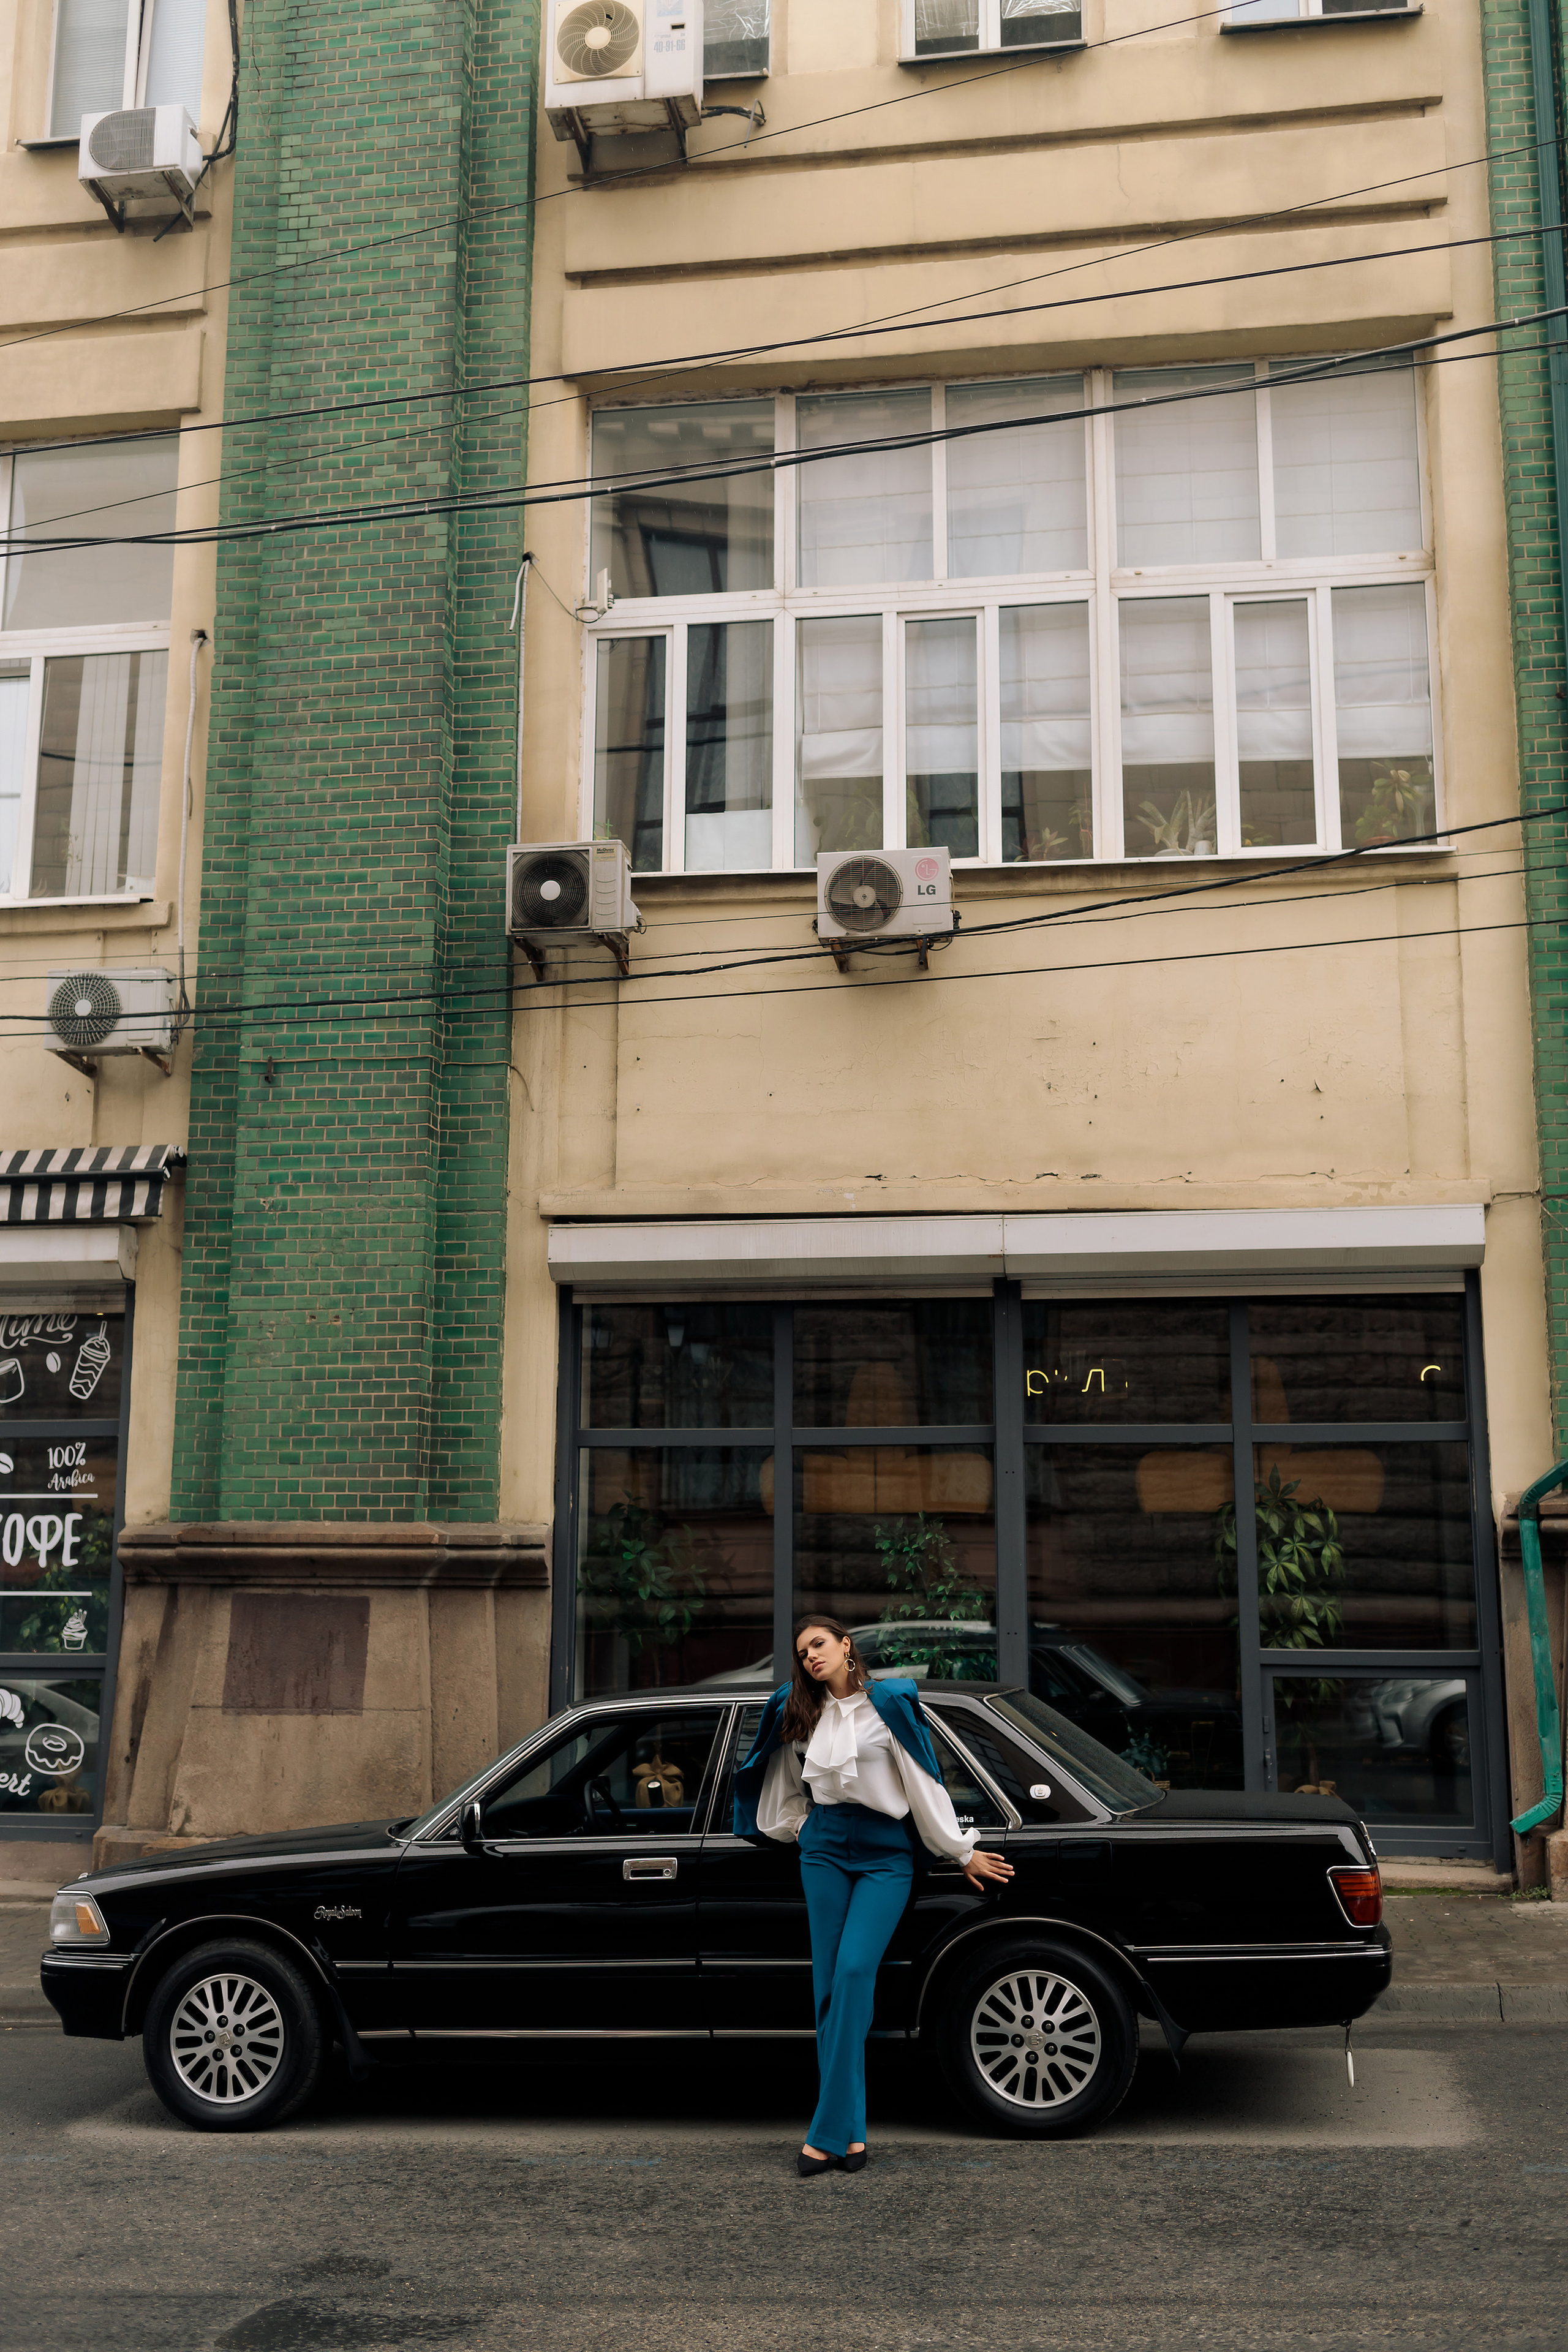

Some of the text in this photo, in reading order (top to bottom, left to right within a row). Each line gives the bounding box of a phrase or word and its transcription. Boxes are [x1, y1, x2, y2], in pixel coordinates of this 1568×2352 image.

[918, 885, 936, 895] LG
[47, 1442, 86, 1469] 100%
[48, 1469, 95, 1491] Arabica
[0, 1513, 83, 1568] ОФЕ
